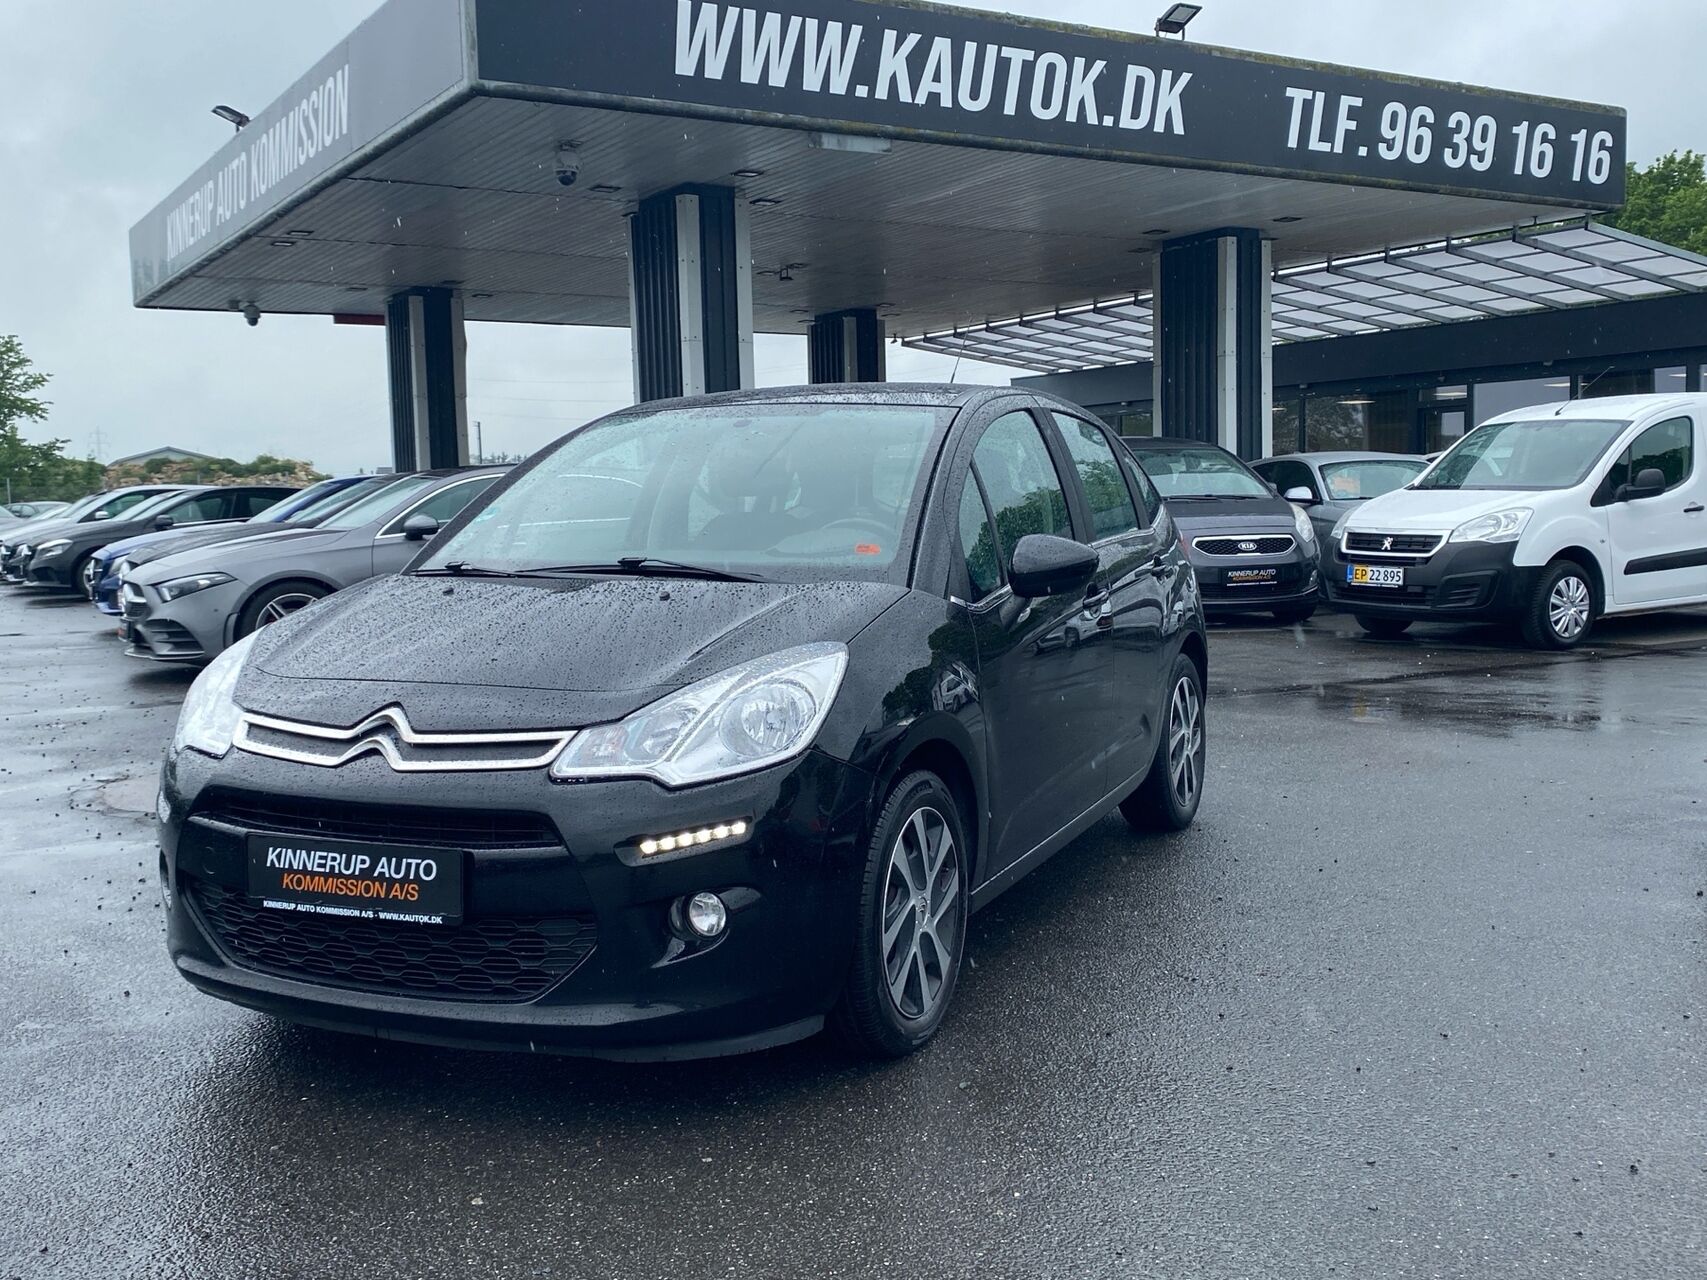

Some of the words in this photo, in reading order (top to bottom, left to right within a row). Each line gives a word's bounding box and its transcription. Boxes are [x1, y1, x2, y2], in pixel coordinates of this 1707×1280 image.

[675, 0, 1193, 136] WWW.KAUTOK.DK
[1285, 87, 1369, 157] TLF.
[1378, 101, 1435, 164] 96
[1444, 111, 1497, 172] 39
[1512, 121, 1556, 178] 16
[1570, 128, 1614, 185] 16
[167, 179, 215, 262] KINNERUP
[216, 152, 247, 226] AUTO
[251, 64, 349, 202] KOMMISSION
[1228, 569, 1259, 578] KINNERUP
[1259, 568, 1277, 576] AUTO
[1354, 569, 1367, 580] EP
[1369, 569, 1381, 581] 22
[1382, 570, 1402, 583] 895
[266, 847, 370, 876] KINNERUP
[373, 857, 437, 881] AUTO
[282, 873, 386, 898] KOMMISSION
[389, 883, 419, 901] A/S
[263, 900, 296, 911] KINNERUP
[297, 903, 315, 913] AUTO
[316, 906, 360, 918] KOMMISSION
[361, 910, 374, 919] A/S
[378, 912, 443, 925] WWW.KAUTOK.DK
